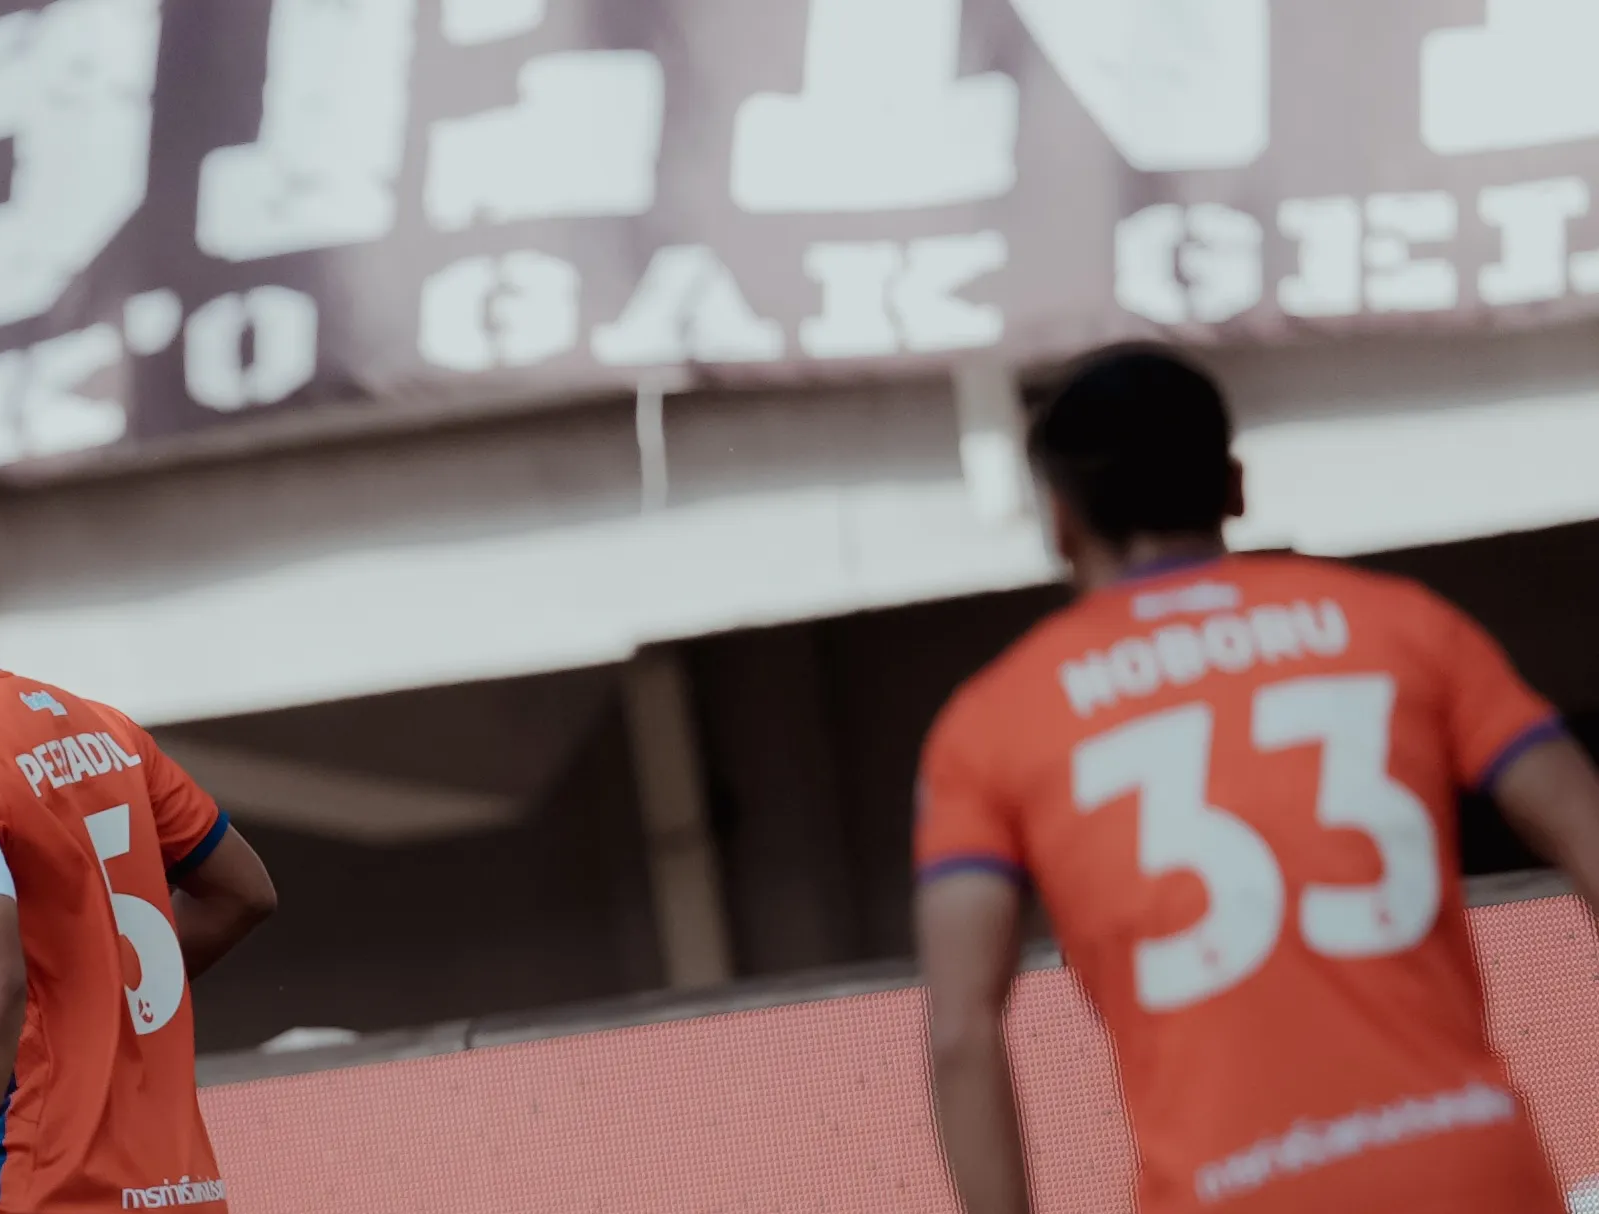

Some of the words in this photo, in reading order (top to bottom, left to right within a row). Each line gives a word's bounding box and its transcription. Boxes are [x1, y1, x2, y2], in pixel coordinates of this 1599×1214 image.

[417, 233, 1006, 372] GAK
[83, 803, 186, 1036] 5
[1071, 671, 1441, 1012] 33
